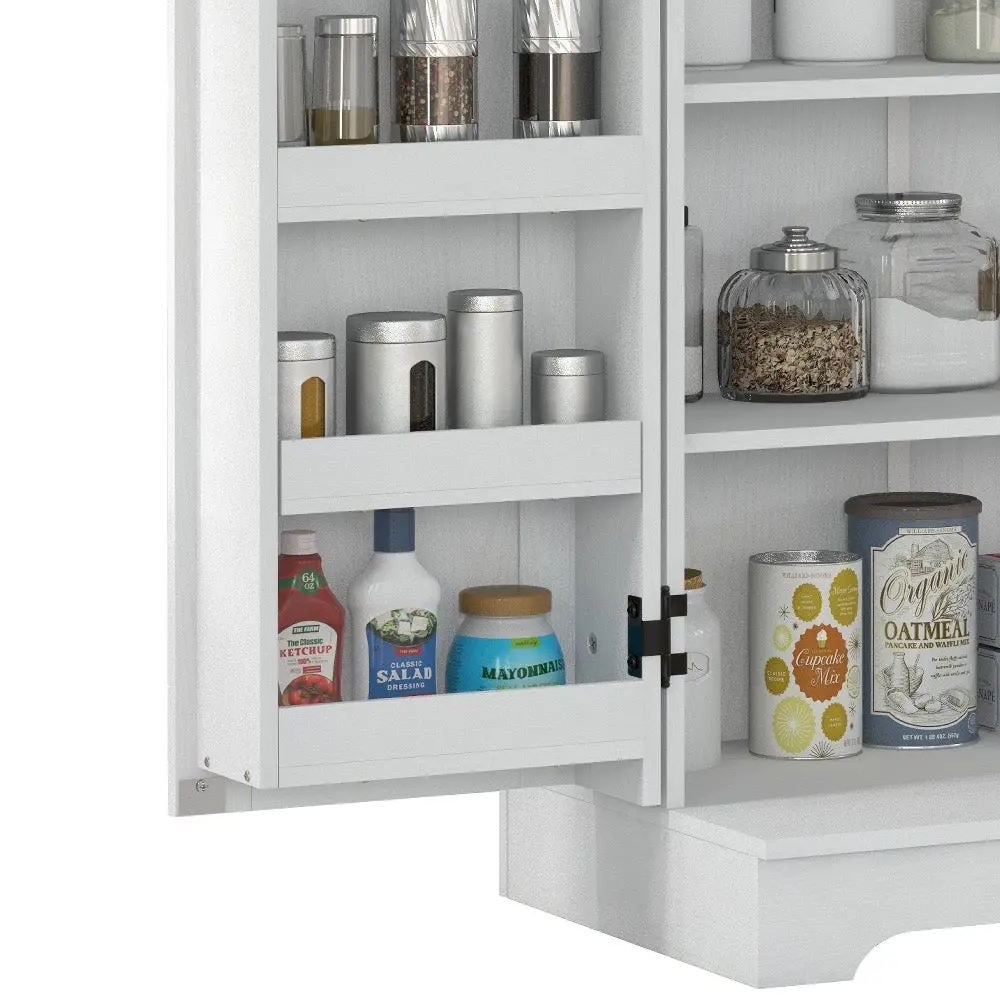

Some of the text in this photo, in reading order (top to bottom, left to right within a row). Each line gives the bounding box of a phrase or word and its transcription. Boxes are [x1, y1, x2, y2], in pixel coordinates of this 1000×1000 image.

[302, 572, 315, 583] 64
[880, 549, 968, 618] Organic
[884, 619, 970, 641] OATMEAL
[300, 638, 323, 646] Classic
[885, 641, 918, 649] PANCAKE
[279, 645, 333, 658] KETCHUP
[390, 660, 423, 668] CLASSIC
[795, 648, 845, 670] Cupcake
[376, 667, 433, 684] SALAD
[810, 667, 841, 687] Mix
[387, 682, 425, 690] DRESSING
